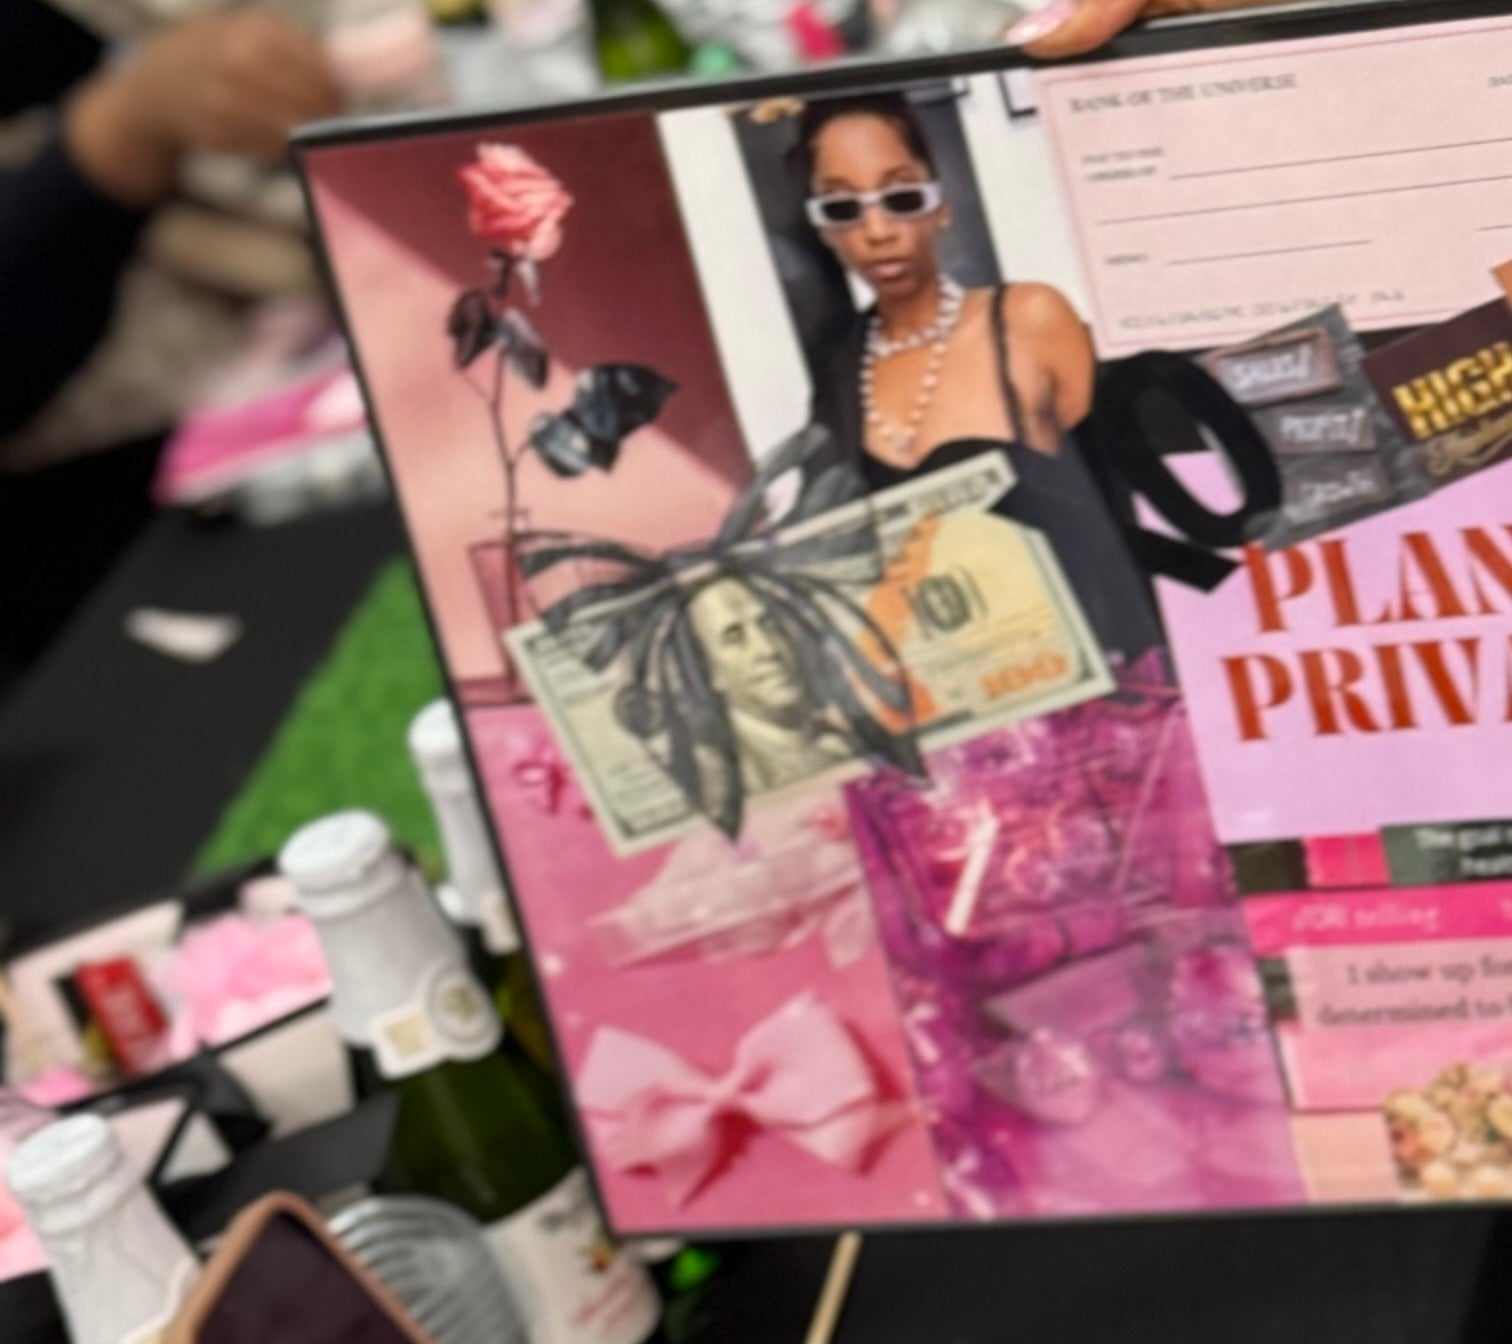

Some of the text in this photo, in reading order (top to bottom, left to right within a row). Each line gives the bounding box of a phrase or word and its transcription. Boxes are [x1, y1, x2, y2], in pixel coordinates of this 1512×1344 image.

[1070, 72, 1297, 113] BANK OF THE UNIVERSE
[1366, 959, 1432, 986] show
[1440, 963, 1475, 989] up
[1317, 996, 1470, 1027] determined
[1476, 999, 1504, 1020] to
